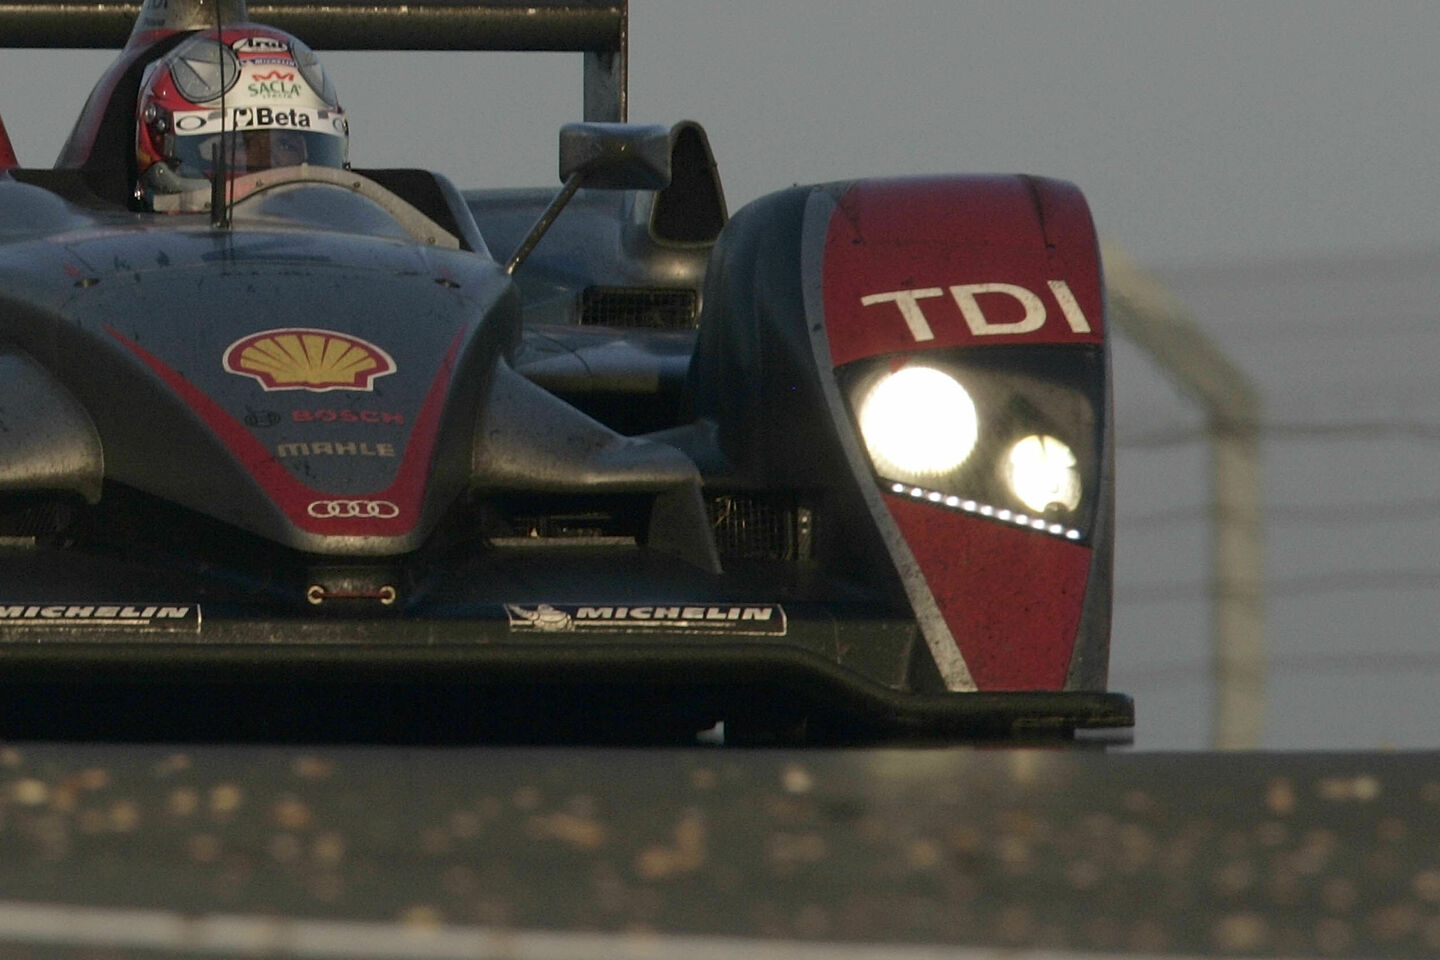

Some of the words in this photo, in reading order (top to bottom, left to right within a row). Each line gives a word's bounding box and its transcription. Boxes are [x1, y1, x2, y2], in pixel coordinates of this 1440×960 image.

[257, 108, 311, 128] Beta
[861, 280, 1091, 342] TDI
[291, 409, 404, 425] BOSCH
[278, 441, 396, 457] MAHLE
[576, 605, 774, 621] MICHELIN
